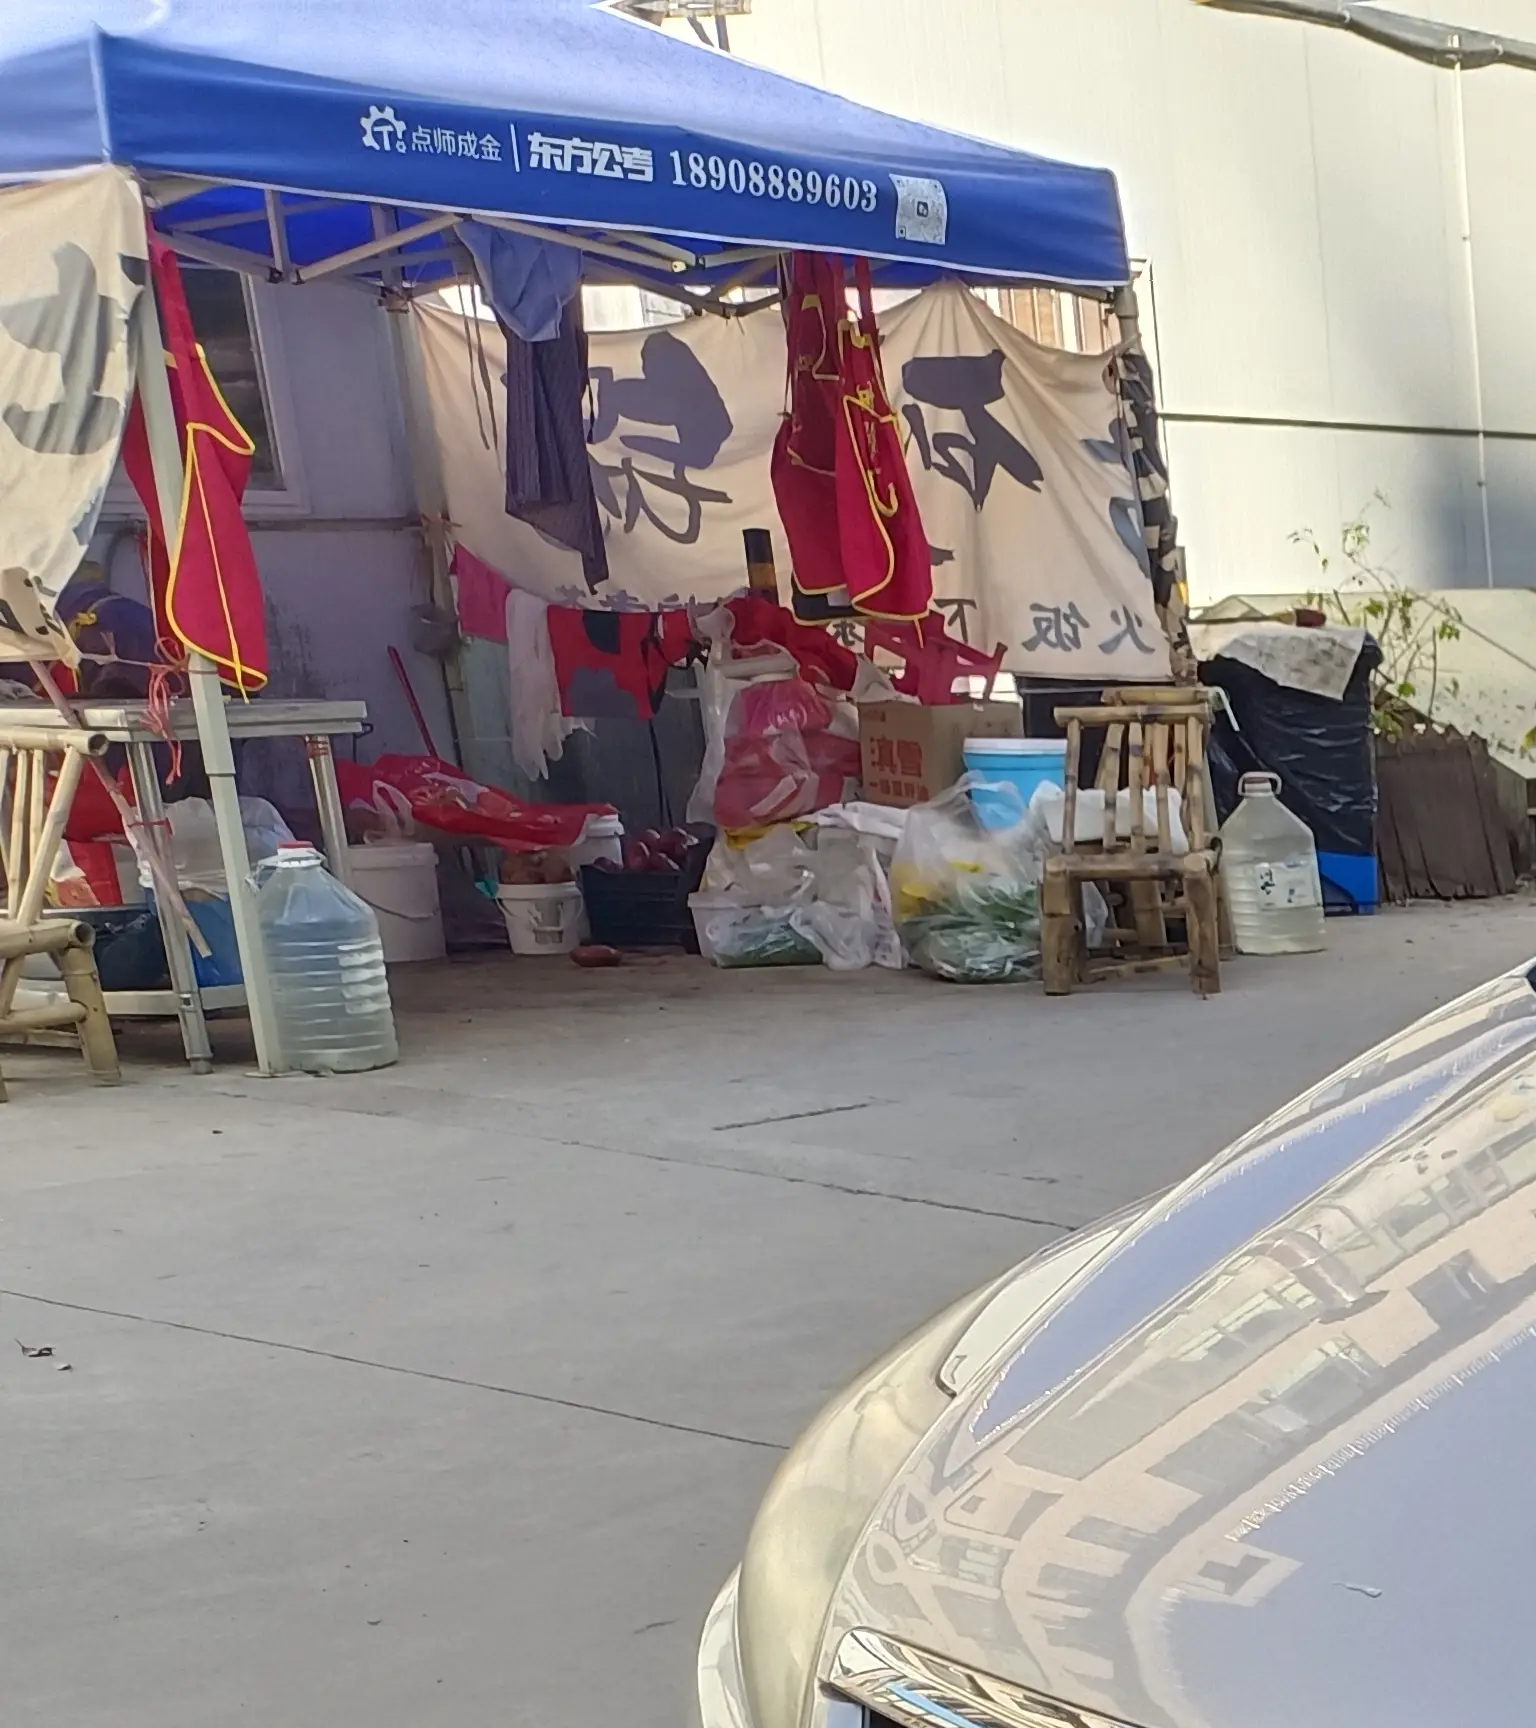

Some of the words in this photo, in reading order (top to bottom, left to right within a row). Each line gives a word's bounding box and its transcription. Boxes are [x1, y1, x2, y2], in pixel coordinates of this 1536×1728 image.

[411, 124, 503, 163] 点师成金
[527, 131, 654, 182] 东方公考
[671, 149, 878, 213] 18908889603
